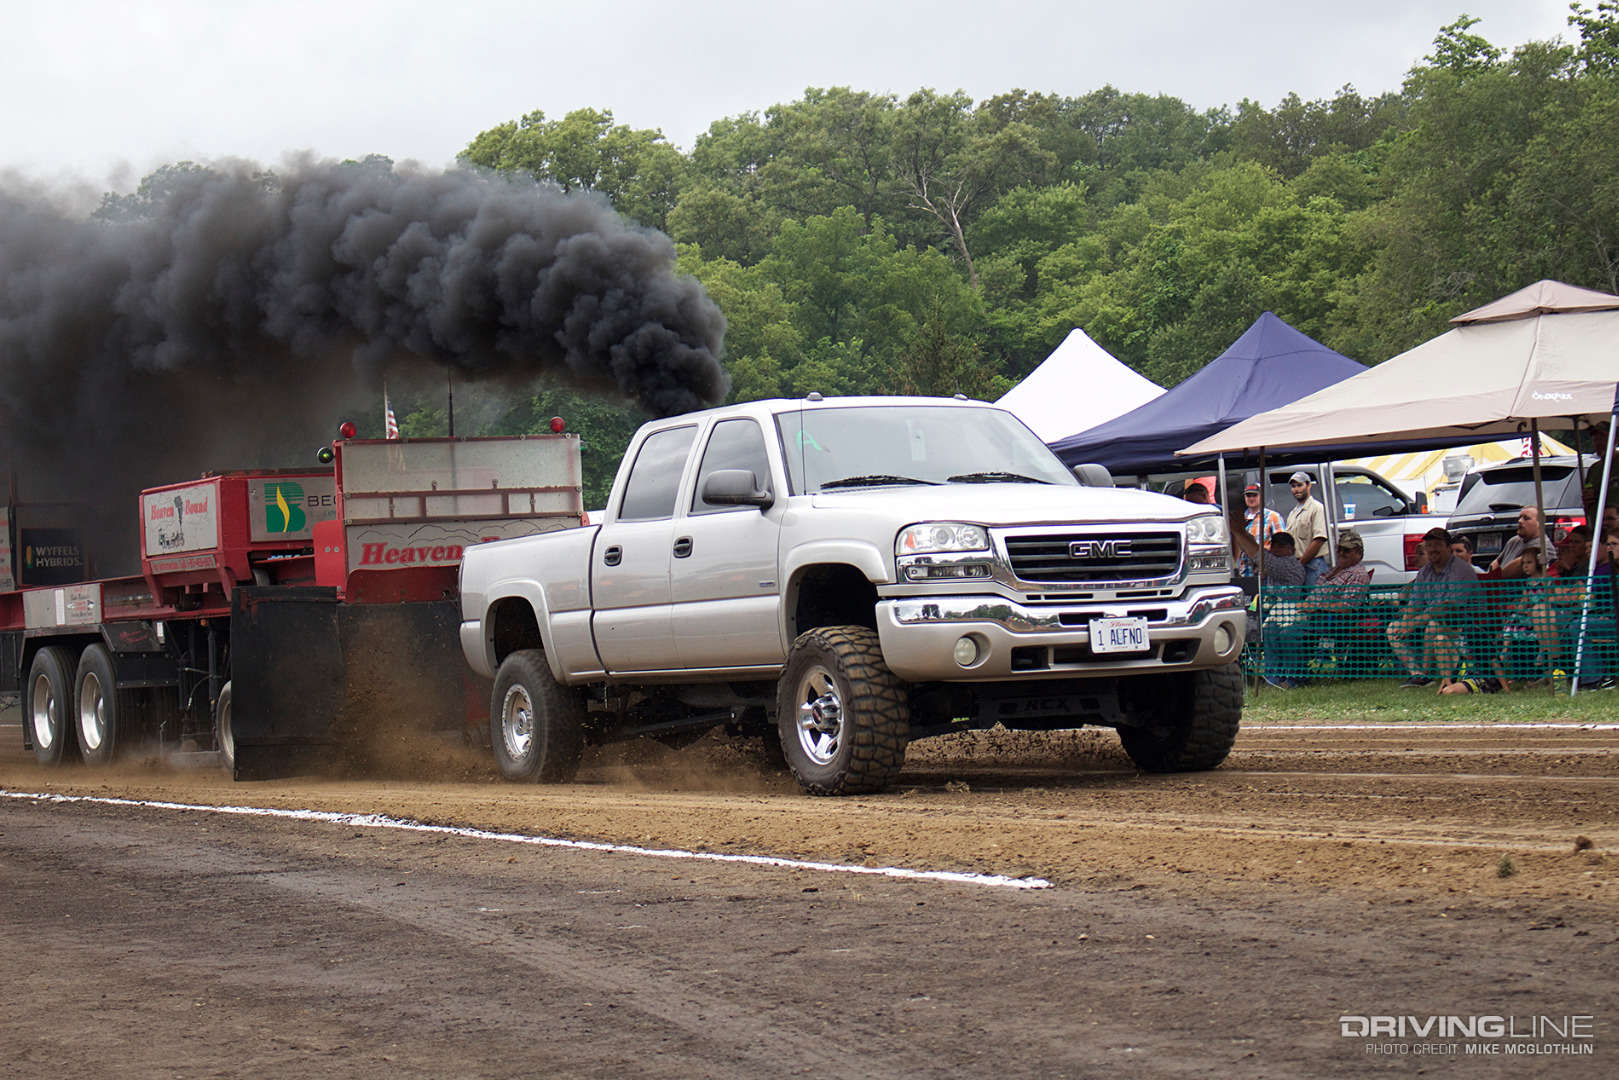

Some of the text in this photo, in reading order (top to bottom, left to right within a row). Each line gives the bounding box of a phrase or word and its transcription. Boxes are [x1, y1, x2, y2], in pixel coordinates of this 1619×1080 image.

[151, 496, 208, 520] Heaven Bound
[35, 546, 80, 556] WYFFELS
[358, 541, 463, 566] Heaven
[1069, 540, 1132, 559] GMC
[36, 557, 80, 567] HYBRIDS
[1098, 630, 1104, 646] 1
